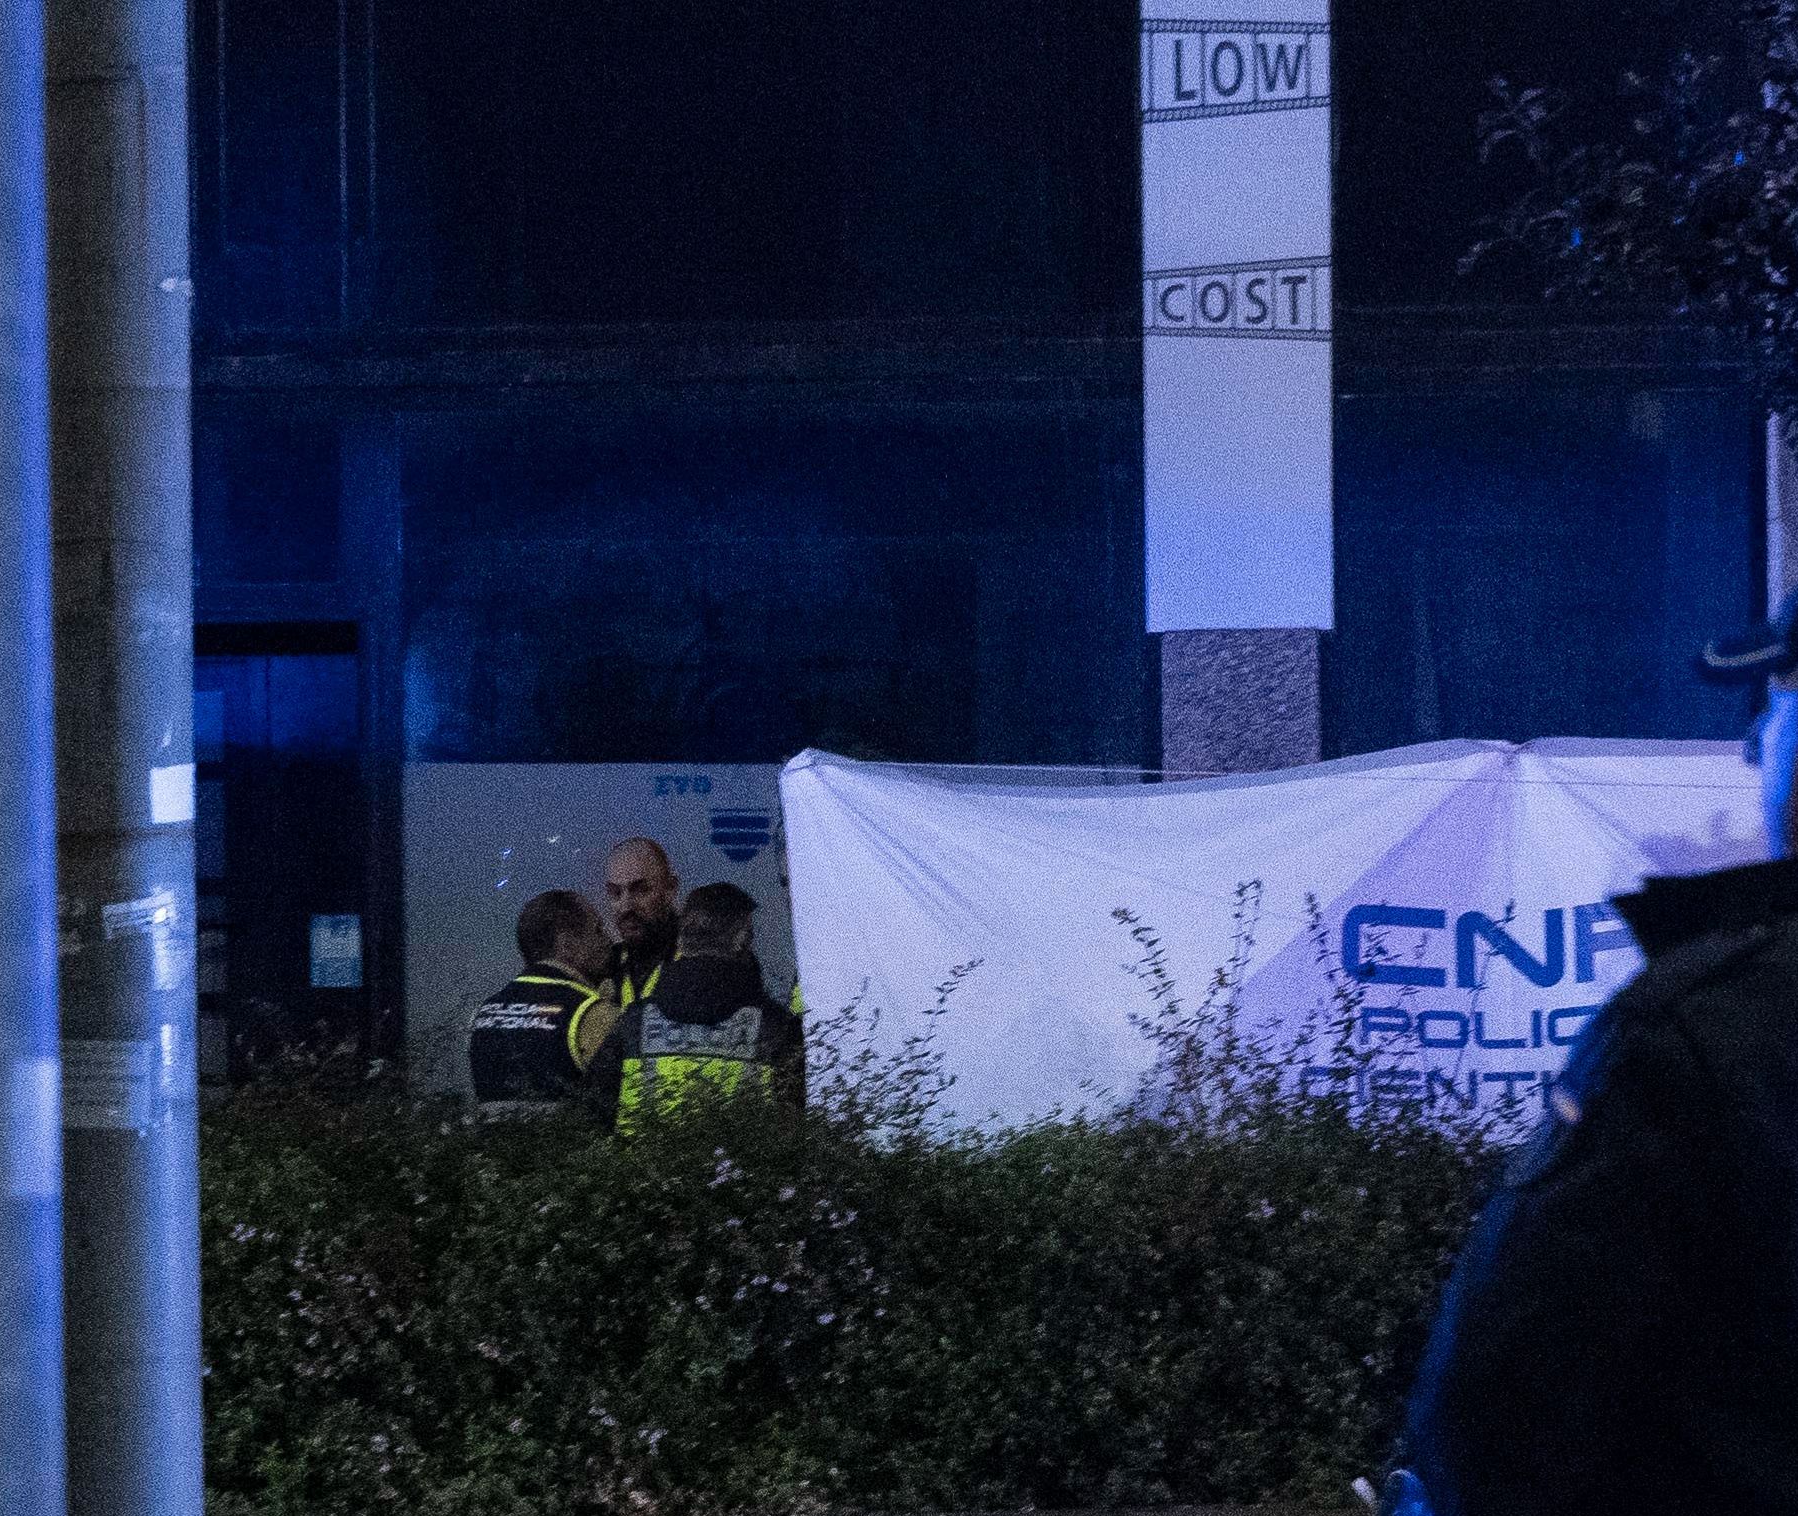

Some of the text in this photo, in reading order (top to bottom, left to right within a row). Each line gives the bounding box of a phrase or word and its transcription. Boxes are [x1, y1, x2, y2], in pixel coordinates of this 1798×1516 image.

[1173, 39, 1304, 101] LOW
[1159, 274, 1307, 326] COST
[1360, 1005, 1603, 1050] POLIC
